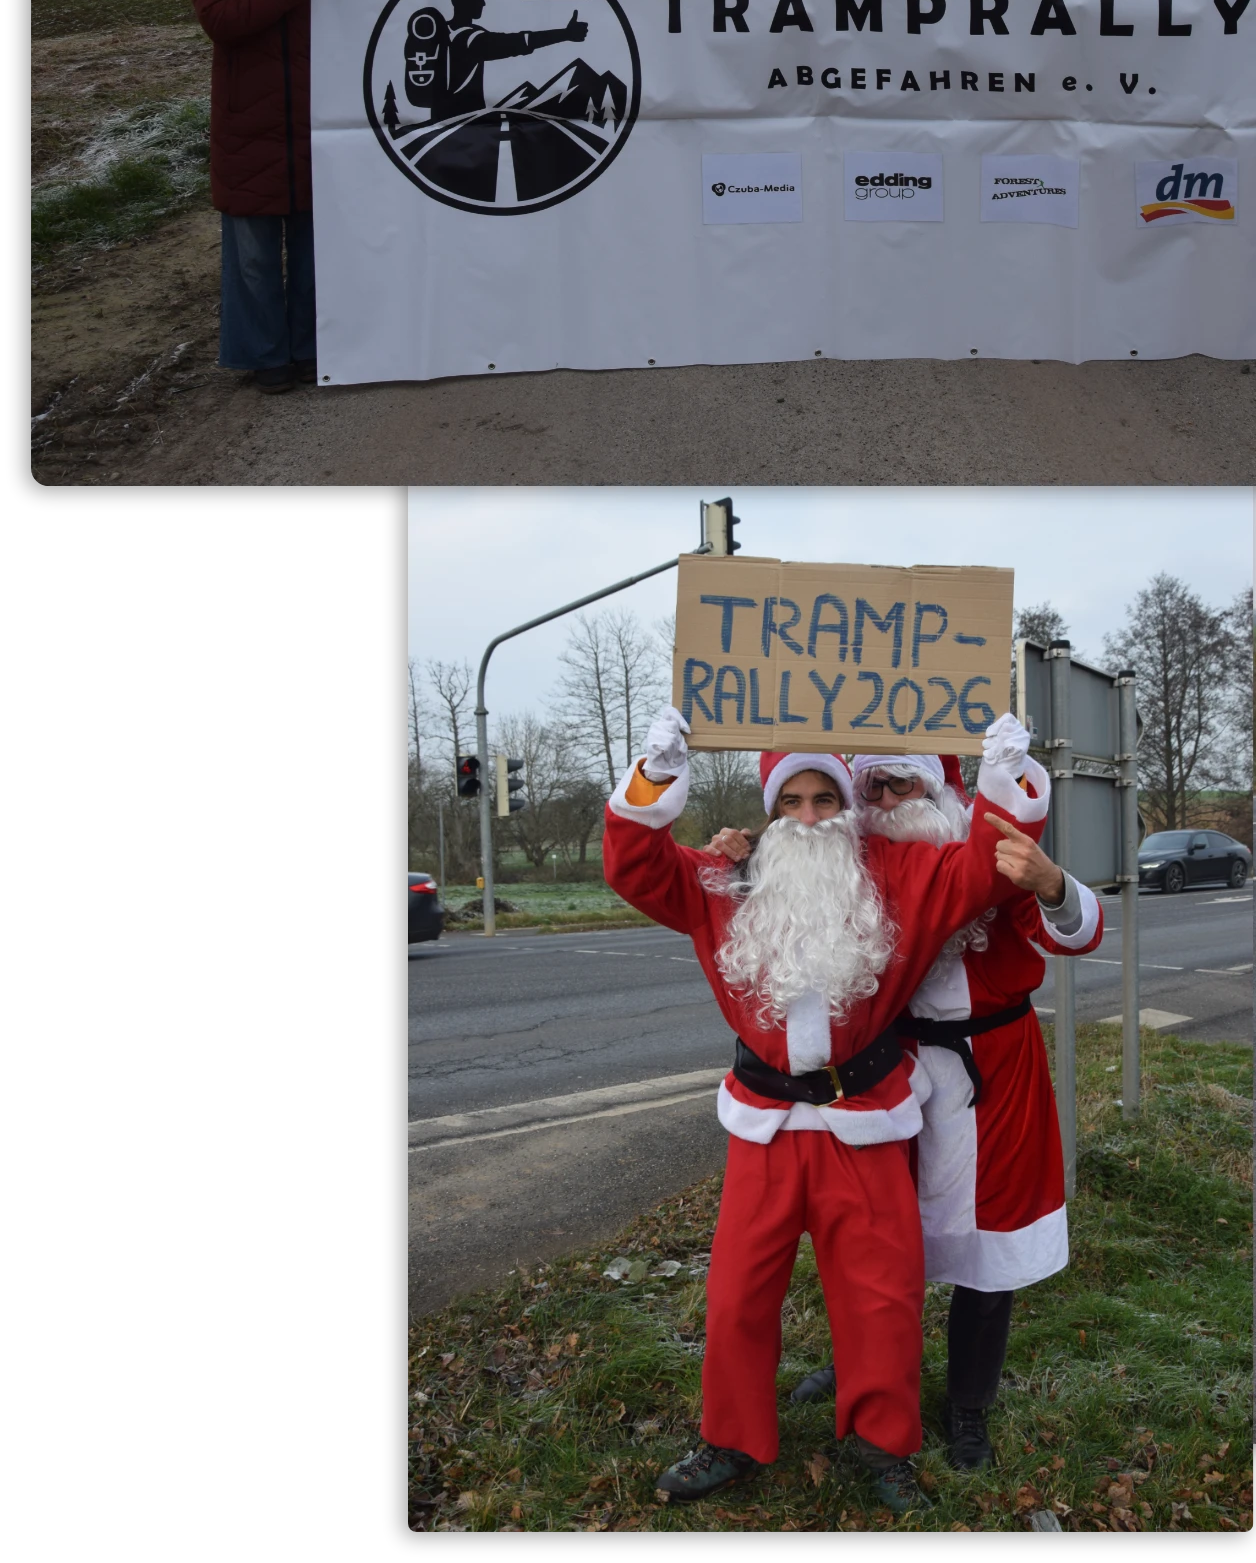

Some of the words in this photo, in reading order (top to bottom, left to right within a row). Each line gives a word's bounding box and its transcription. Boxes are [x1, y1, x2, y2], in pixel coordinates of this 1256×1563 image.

[767, 65, 1036, 93] ABGEFAHREN
[727, 183, 795, 194] Czuba-Media
[854, 172, 932, 190] edding
[993, 177, 1040, 186] FOREST
[1155, 163, 1224, 202] dm
[854, 187, 915, 201] group
[991, 187, 1067, 201] ADVENTURES
[700, 593, 987, 669] TRAMP-
